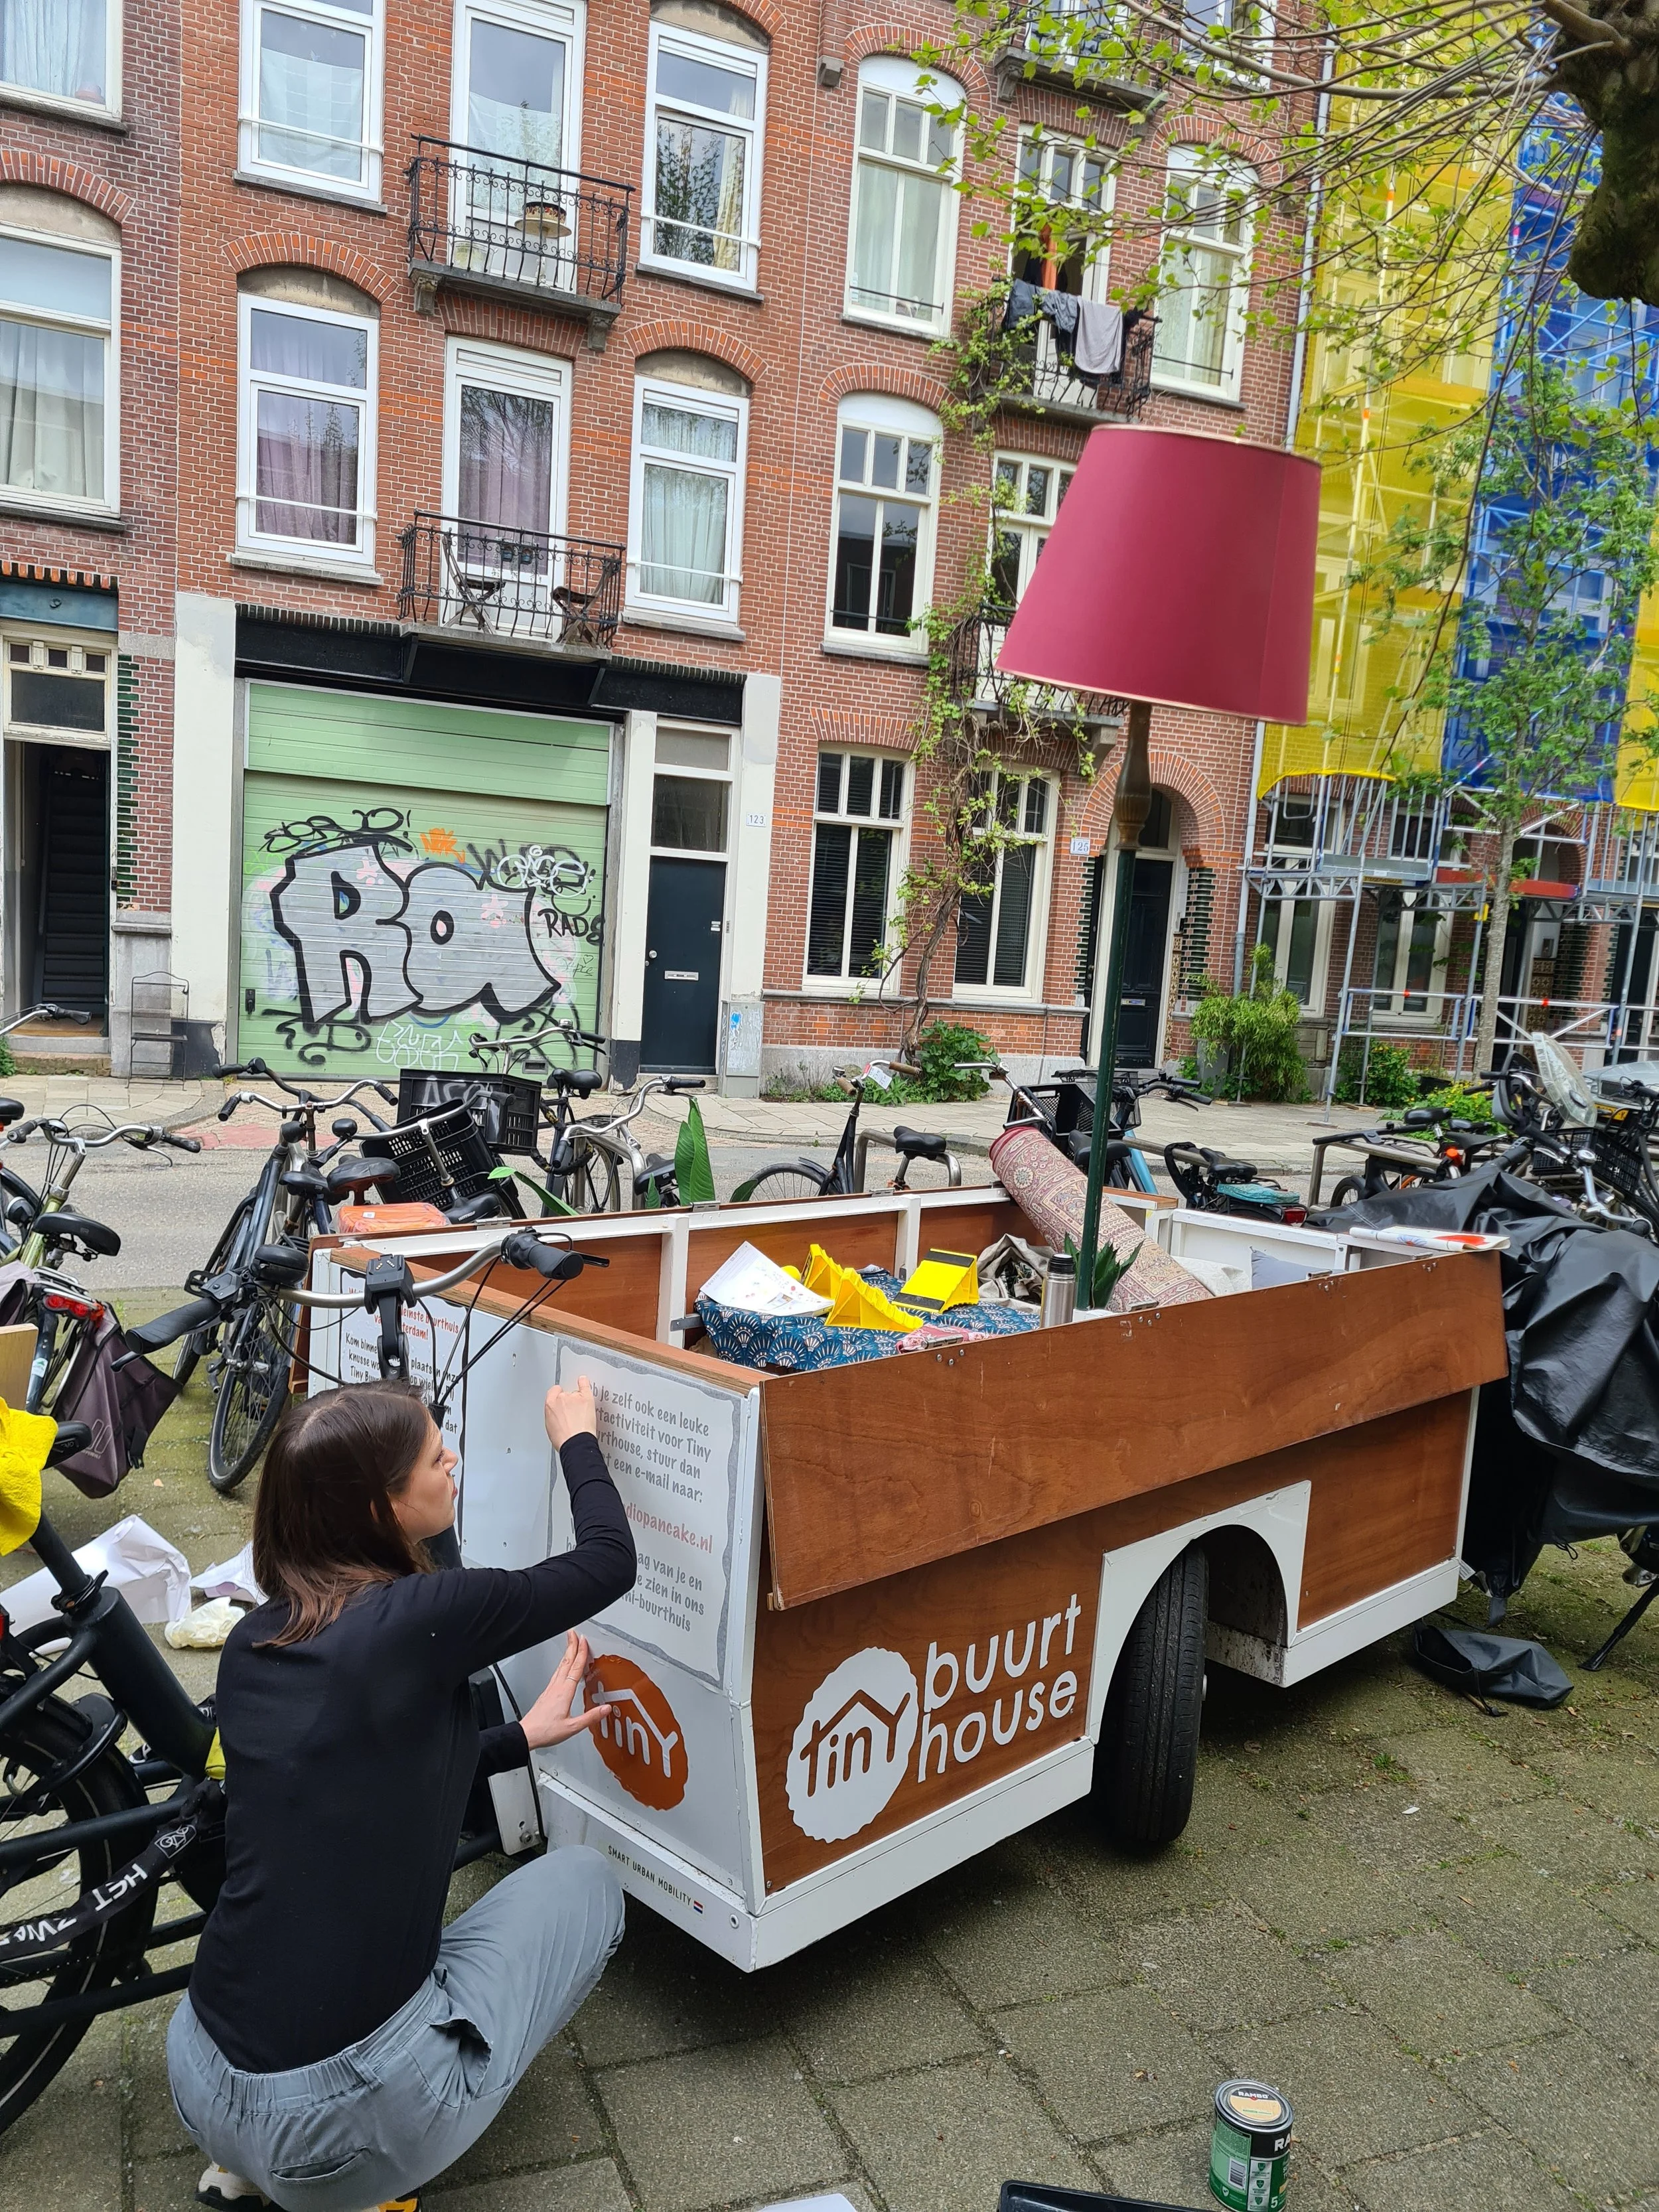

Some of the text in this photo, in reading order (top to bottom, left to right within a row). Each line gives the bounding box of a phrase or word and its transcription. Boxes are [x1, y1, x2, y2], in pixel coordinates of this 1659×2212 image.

[749, 814, 764, 824] 123
[1072, 841, 1090, 855] 125
[401, 1306, 424, 1322] leinste
[402, 1321, 429, 1340] terdam!
[346, 1332, 360, 1348] Kom
[360, 1338, 378, 1354] binne
[411, 1357, 432, 1374] plaats
[349, 1349, 370, 1367] knusse
[350, 1365, 363, 1381] Tiny
[445, 1420, 458, 1434] dat
[601, 1386, 609, 1402] je
[612, 1392, 632, 1410] zelf
[635, 1400, 654, 1418] ook
[658, 1408, 676, 1425] een
[680, 1411, 709, 1436] leuke
[658, 1430, 684, 1449] voor
[687, 1438, 711, 1463] Tiny
[647, 1448, 678, 1469] stuur
[680, 1459, 701, 1479] dan
[614, 1458, 632, 1475] een
[634, 1466, 670, 1490] e-mail
[672, 1481, 703, 1503] naar:
[625, 1502, 713, 1554] diopancake.nl
[653, 1558, 674, 1578] van
[676, 1566, 685, 1584] je
[689, 1576, 702, 1591] en
[644, 1577, 668, 1598] zien
[671, 1586, 682, 1604] in
[685, 1596, 704, 1615] ons
[924, 1593, 1082, 1714] buurt
[918, 1670, 1078, 1783] house
[608, 1845, 691, 1906] SMART URBAN MOBILITY
[1238, 2091, 1269, 2099] RAMBO
